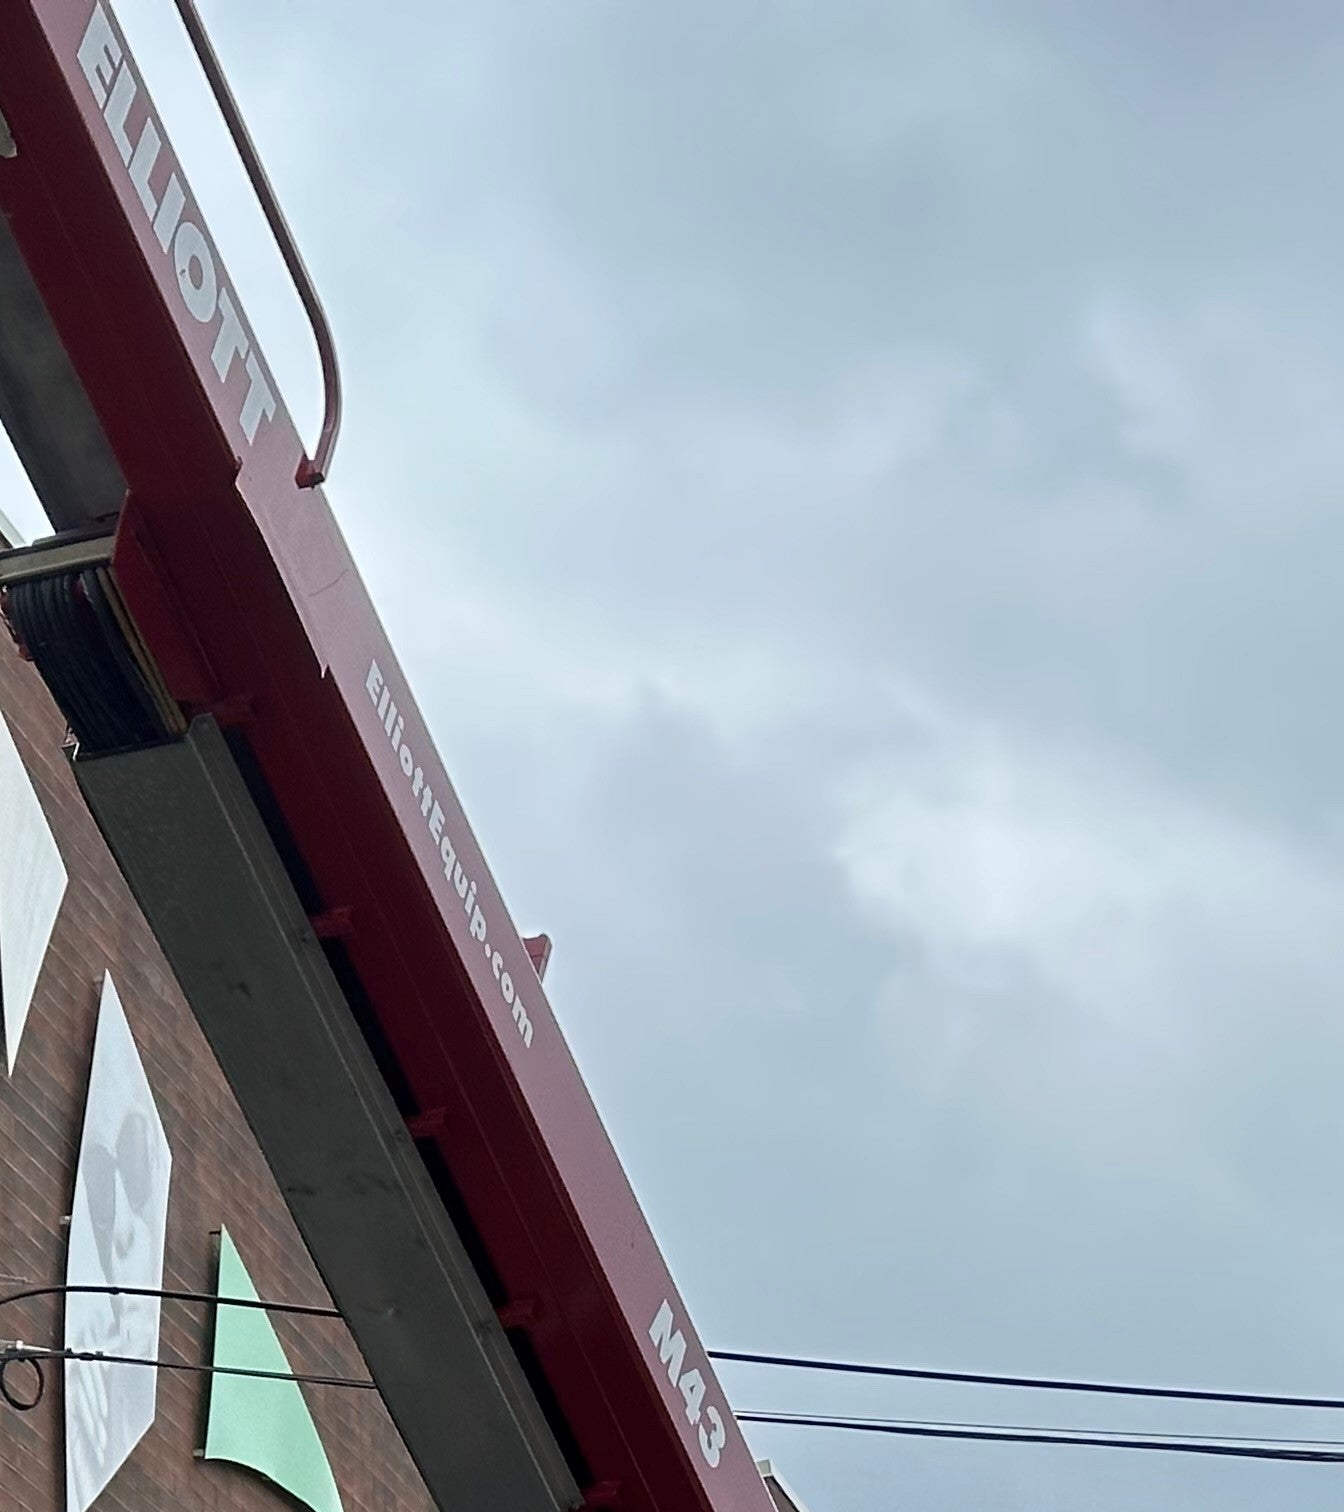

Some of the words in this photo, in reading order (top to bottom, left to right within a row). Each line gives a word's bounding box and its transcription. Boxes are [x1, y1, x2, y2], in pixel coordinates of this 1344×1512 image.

[76, 6, 276, 446] ELLIOTT
[366, 659, 535, 1048] ElliottEquip.com
[648, 1298, 726, 1468] M43
